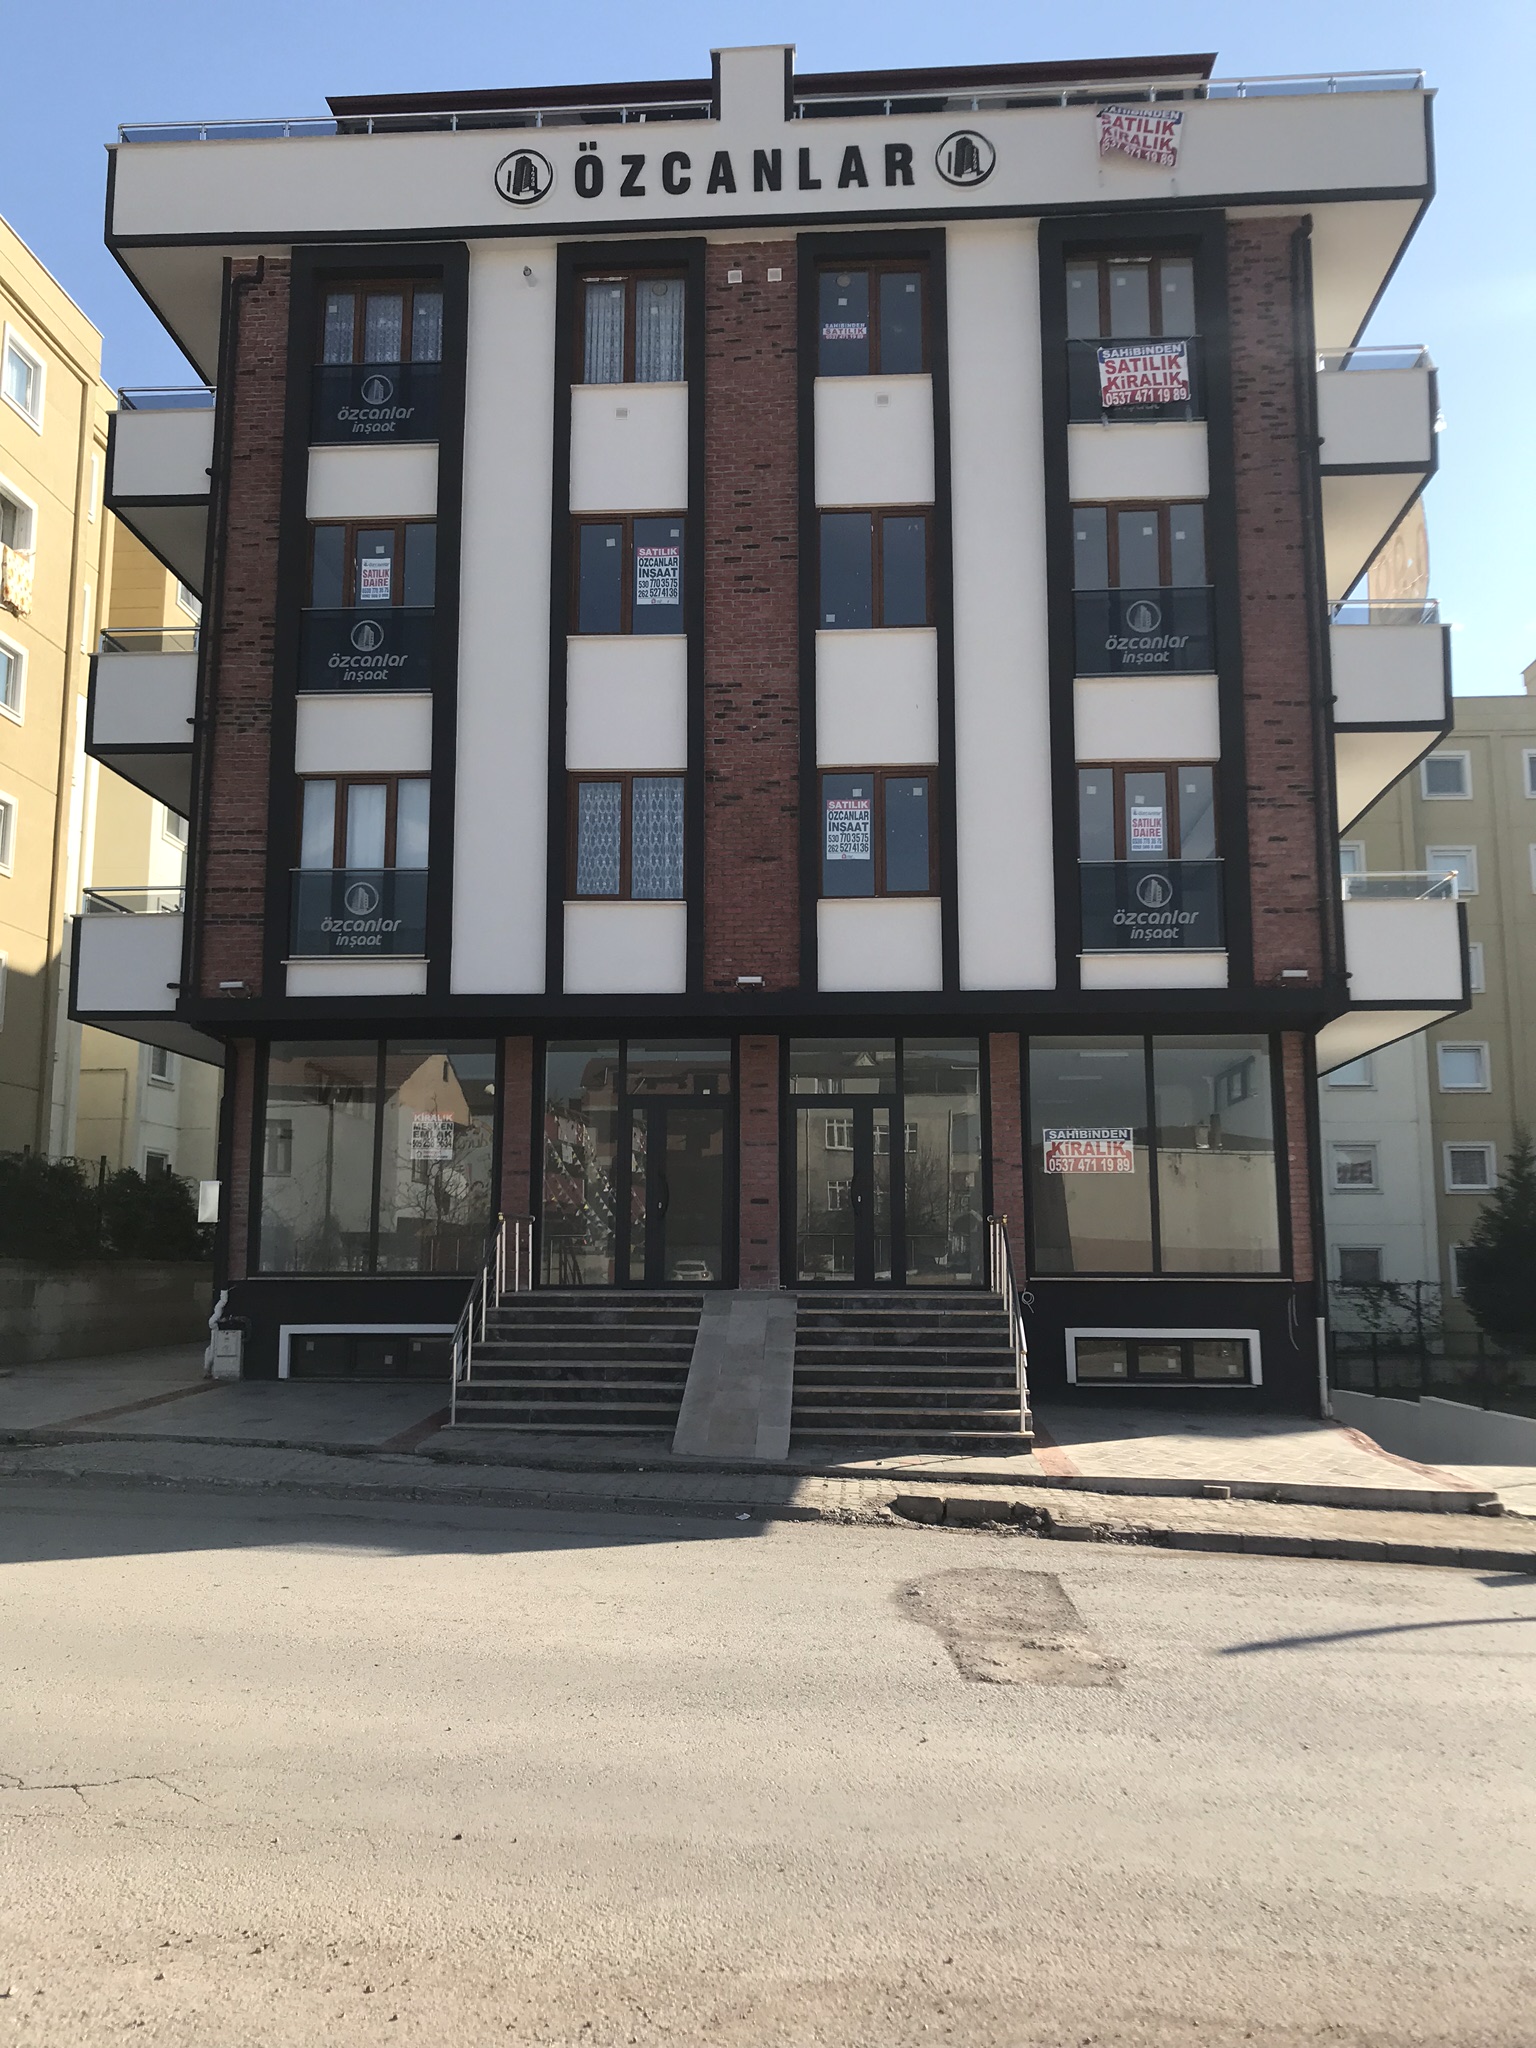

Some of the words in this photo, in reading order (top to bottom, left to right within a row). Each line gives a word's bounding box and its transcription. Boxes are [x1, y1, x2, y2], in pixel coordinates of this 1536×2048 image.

[1101, 114, 1176, 136] SATILIK
[1145, 151, 1158, 163] 19
[1160, 152, 1175, 167] 89
[574, 141, 916, 199] ÖZCANLAR
[1105, 355, 1182, 374] SATILIK
[1105, 392, 1132, 405] 0537
[1135, 389, 1154, 402] 471
[1158, 389, 1170, 402] 19
[1173, 387, 1187, 400] 89
[337, 406, 415, 420] özcanlar
[352, 421, 396, 434] inşaat
[639, 548, 678, 556] SATILIK
[362, 569, 390, 578] SATILIK
[1105, 635, 1189, 650] özcanlar
[328, 653, 408, 668] özcanlar
[1122, 651, 1170, 665] inşaat
[343, 669, 388, 682] inşaat
[828, 801, 868, 809] SATILIK
[1132, 818, 1162, 827] SATILIK
[321, 917, 402, 932] özcanlar
[1112, 909, 1199, 925] özcanlar
[336, 933, 383, 948] inşaat
[1130, 926, 1179, 941] inşaat
[1049, 1159, 1074, 1171] 0537
[1078, 1158, 1096, 1171] 471
[1101, 1158, 1114, 1171] 19
[1117, 1158, 1130, 1171] 89
